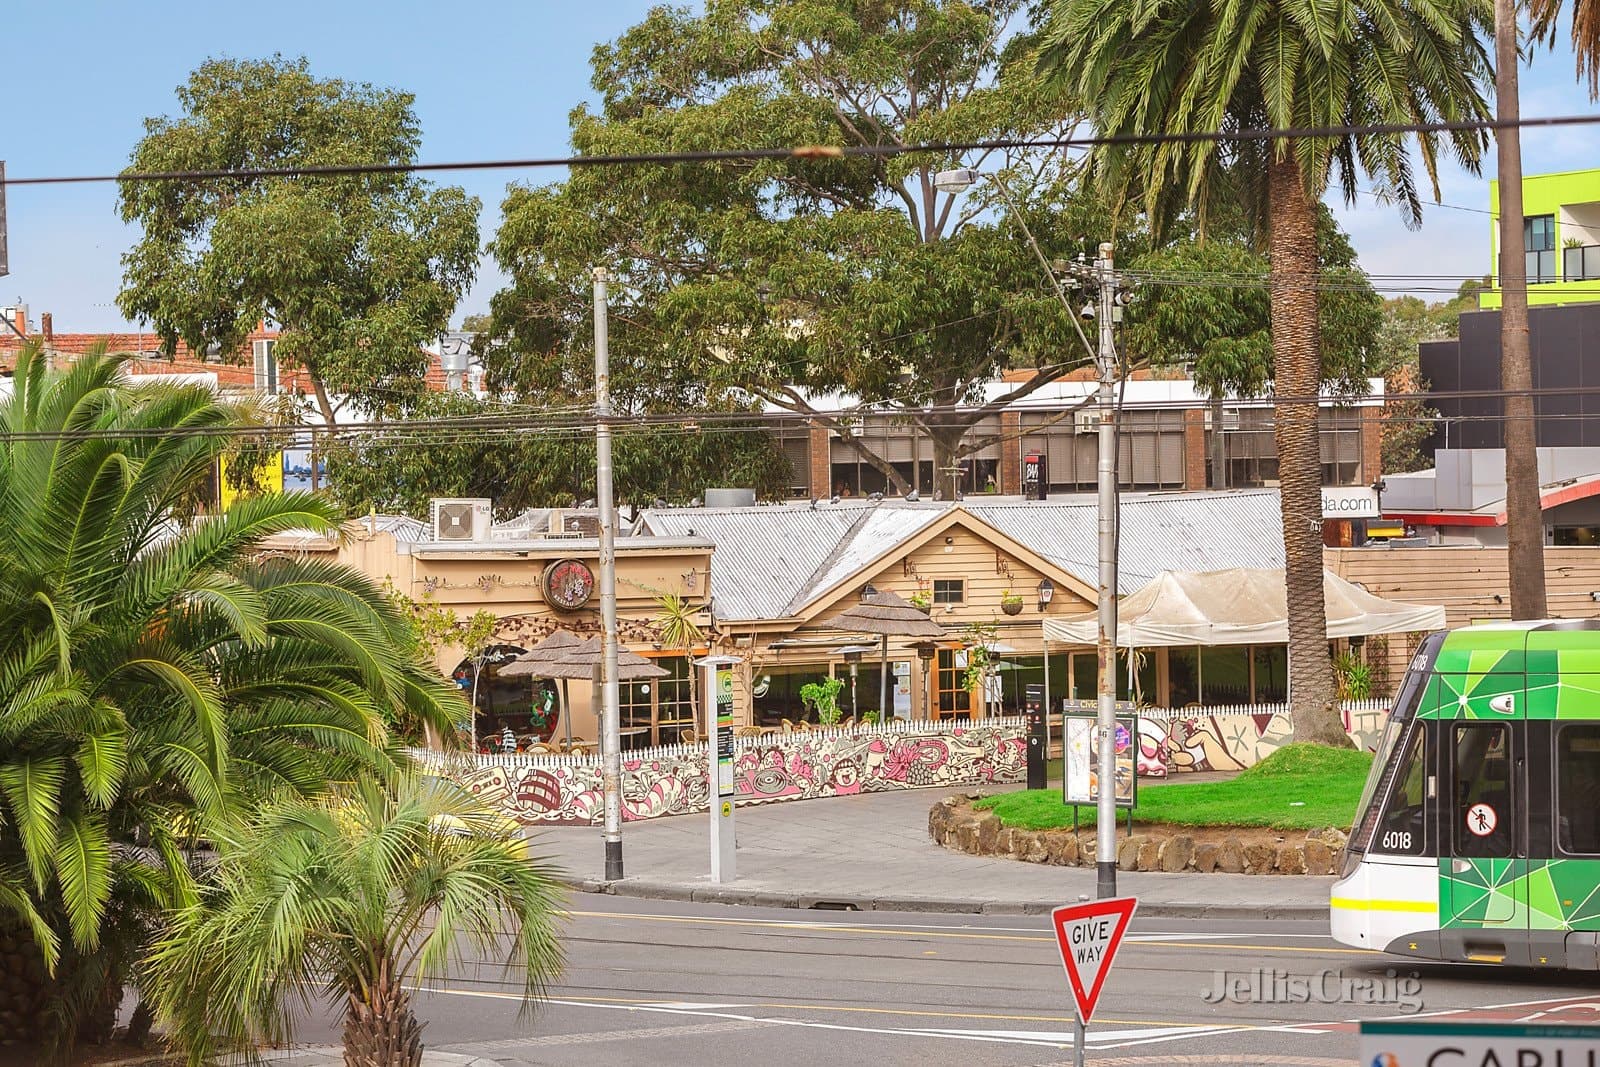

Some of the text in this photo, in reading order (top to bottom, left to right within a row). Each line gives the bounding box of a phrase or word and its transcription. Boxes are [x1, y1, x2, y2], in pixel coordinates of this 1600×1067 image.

[1383, 831, 1412, 849] 6018
[1072, 921, 1109, 945] GIVE
[1077, 945, 1103, 964] WAY
